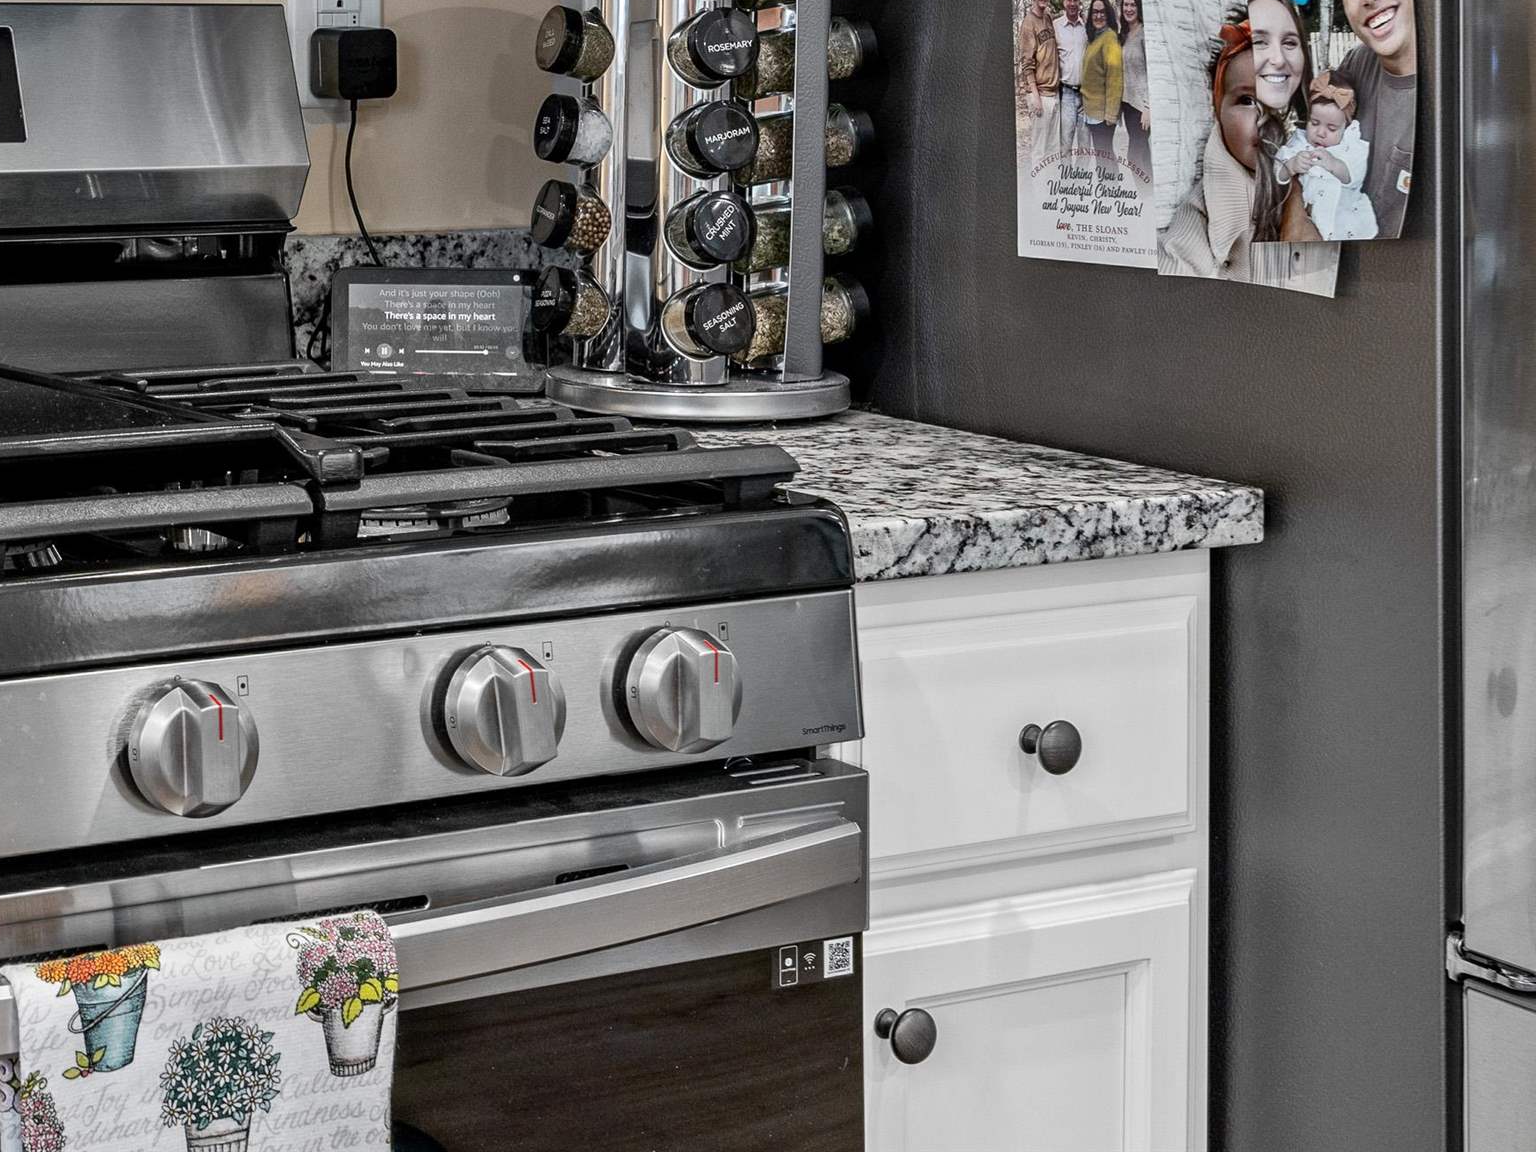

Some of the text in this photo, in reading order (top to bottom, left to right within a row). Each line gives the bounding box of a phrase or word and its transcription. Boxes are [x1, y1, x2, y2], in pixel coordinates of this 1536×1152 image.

[707, 39, 753, 53] ROSEMARY
[705, 126, 751, 145] MARJORAM
[1058, 164, 1123, 185] Wishing You a
[1047, 179, 1138, 201] Wonderful Christmas
[1042, 196, 1143, 218] and Joyous New Year!
[705, 205, 736, 241] CRUSHED
[718, 220, 737, 241] MINT
[1076, 223, 1129, 235] THE SLOANS
[1107, 245, 1120, 253] AND
[379, 289, 397, 297] And
[411, 289, 427, 299] just
[429, 290, 448, 299] your
[450, 289, 474, 299] shape
[458, 302, 471, 310] my
[473, 301, 495, 309] heart
[384, 311, 414, 320] There's
[423, 313, 447, 322] space
[448, 312, 456, 320] in
[458, 314, 471, 322] my
[473, 312, 496, 321] heart
[703, 301, 745, 331] SEASONING
[363, 322, 378, 331] You
[380, 323, 402, 331] don't
[404, 323, 421, 331] love
[477, 324, 503, 332] know
[719, 317, 737, 333] SALT
[432, 334, 448, 342] will
[799, 723, 847, 736] SmartThings
[142, 976, 236, 1025] Simply
[251, 1101, 365, 1135] Kindness
